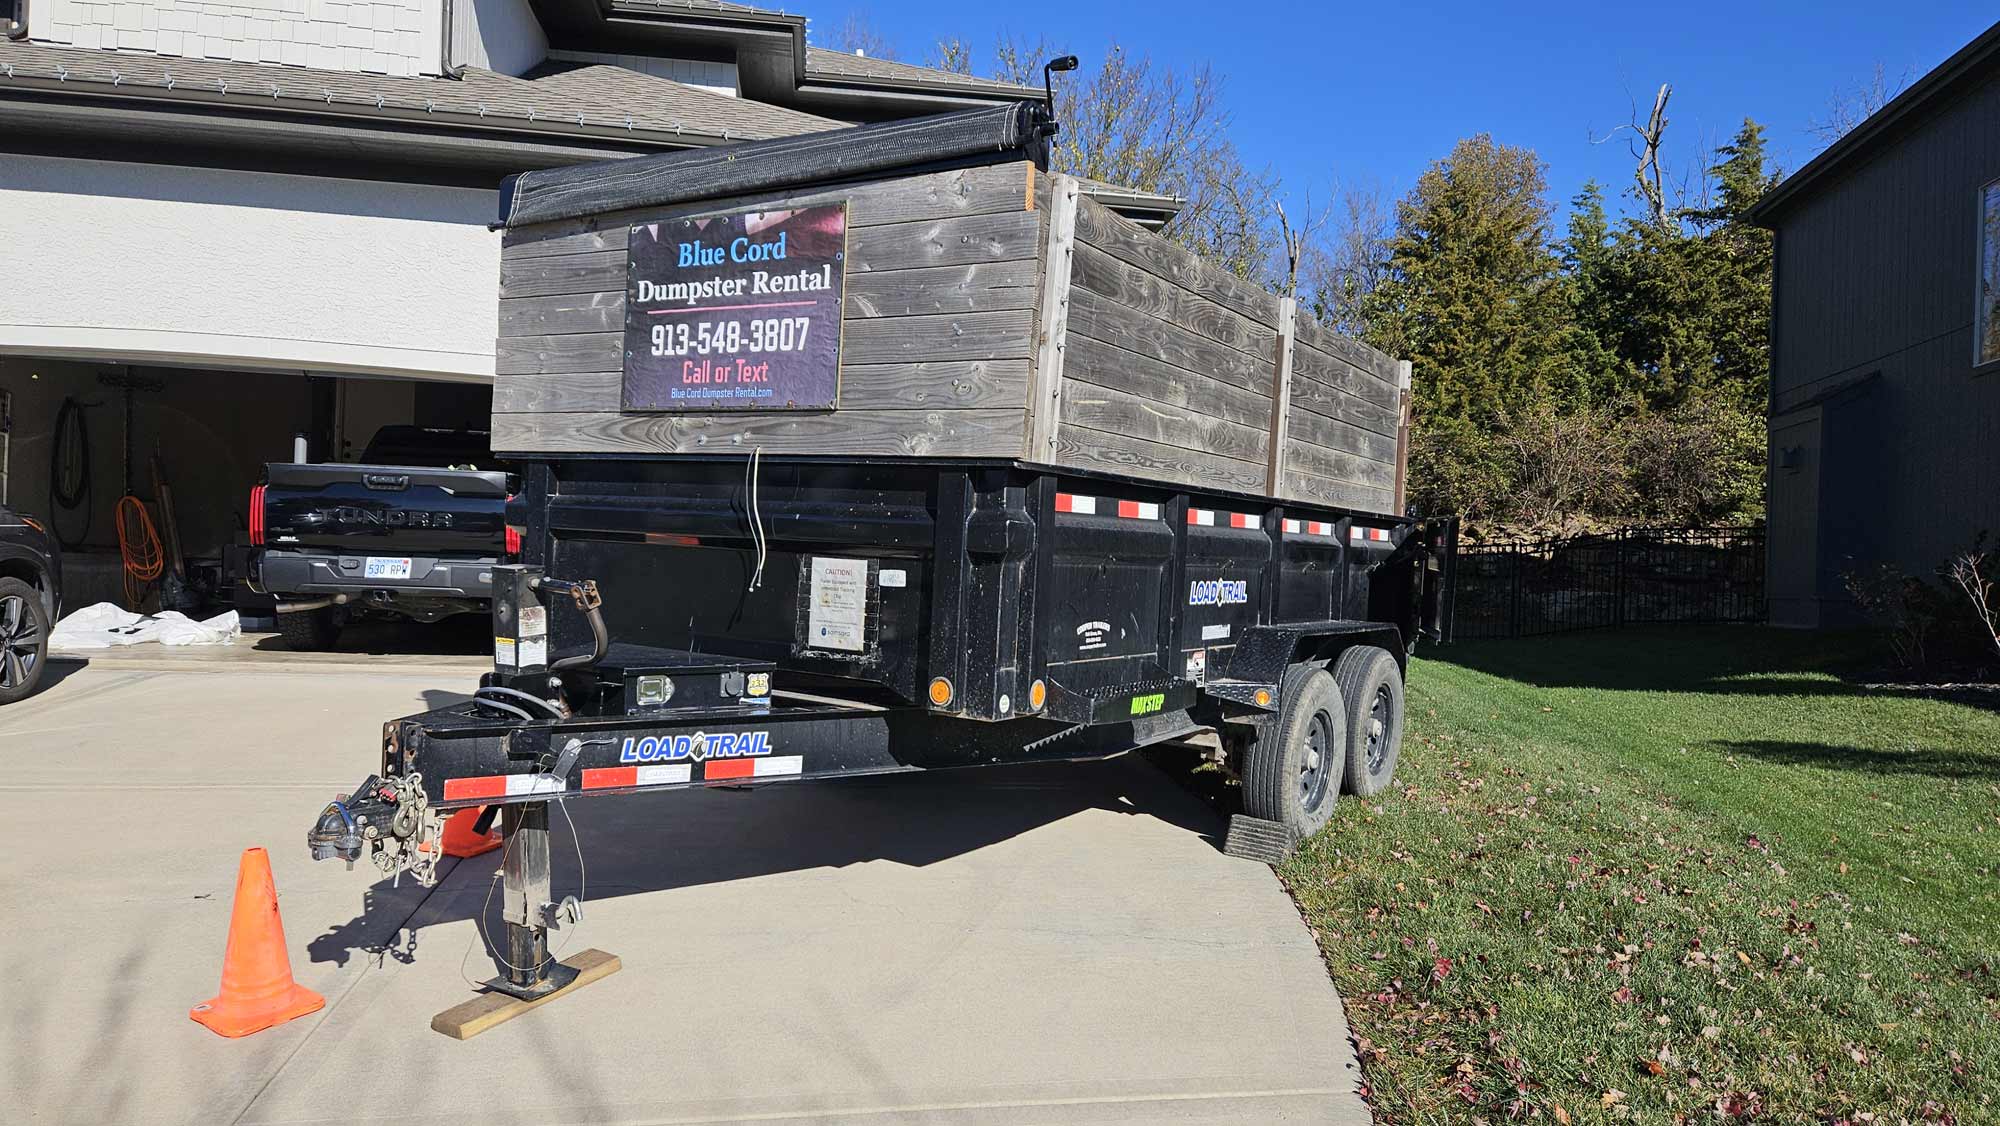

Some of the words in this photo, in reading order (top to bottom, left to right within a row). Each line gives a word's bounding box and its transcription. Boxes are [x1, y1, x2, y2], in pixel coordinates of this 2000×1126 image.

[677, 240, 726, 268] Blue
[730, 231, 787, 263] Cord
[637, 276, 747, 305] Dumpster
[752, 263, 832, 295] Rental
[651, 317, 810, 356] 913-548-3807
[682, 360, 711, 384] Call
[715, 365, 731, 383] or
[736, 359, 769, 383] Text
[671, 388, 685, 398] Blue
[687, 387, 701, 398] Cord
[702, 387, 734, 399] Dumpster
[735, 386, 773, 398] Rental.com
[1190, 581, 1217, 605] LOAD
[1222, 580, 1248, 603] TRAIL
[620, 736, 689, 762] LOAD
[704, 731, 772, 758] TRAIL
